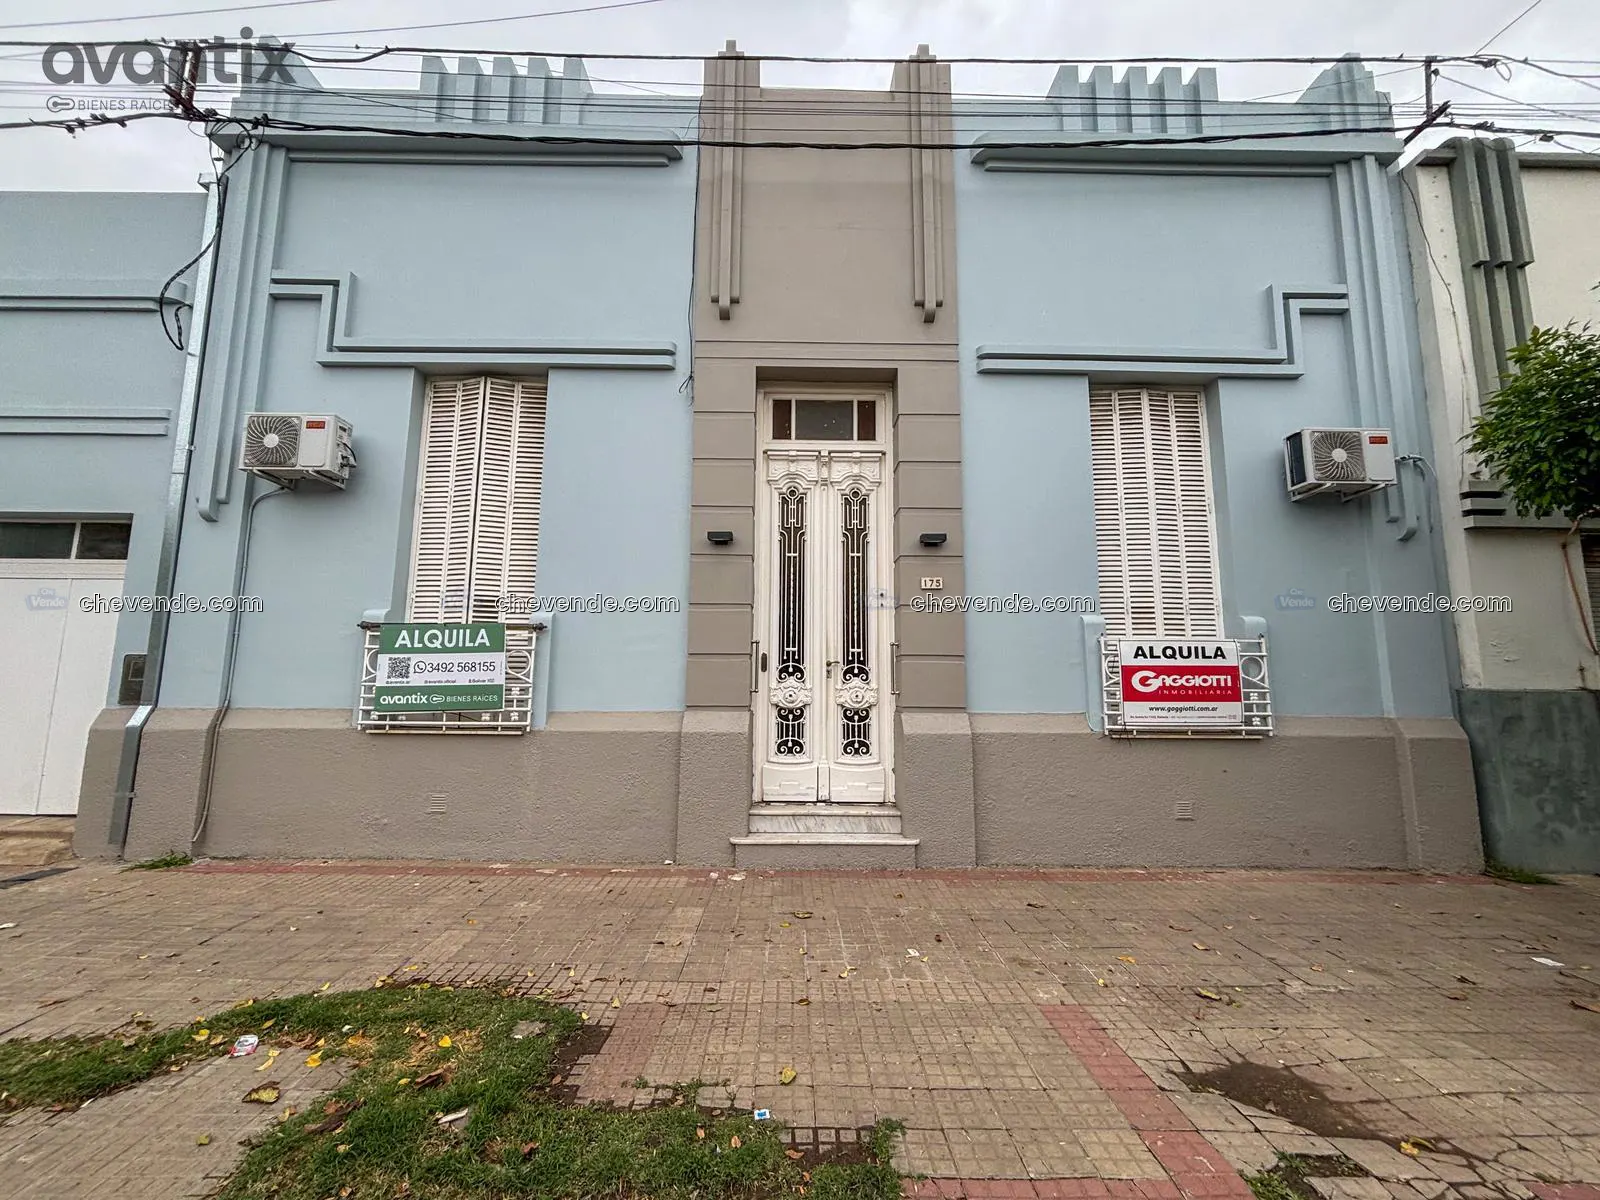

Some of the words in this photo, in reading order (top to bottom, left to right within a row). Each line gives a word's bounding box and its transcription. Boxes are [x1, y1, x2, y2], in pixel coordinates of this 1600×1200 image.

[924, 579, 941, 587] 175
[394, 628, 491, 649] ALQUILA
[1133, 645, 1226, 660] ALQUILA
[427, 662, 454, 673] 3492
[456, 661, 496, 672] 568155
[1131, 670, 1232, 693] GAGGIOTTI
[380, 692, 428, 705] avantix
[472, 694, 498, 702] RAÍCES
[1149, 705, 1218, 713] www.gaggiotti.com.ar
